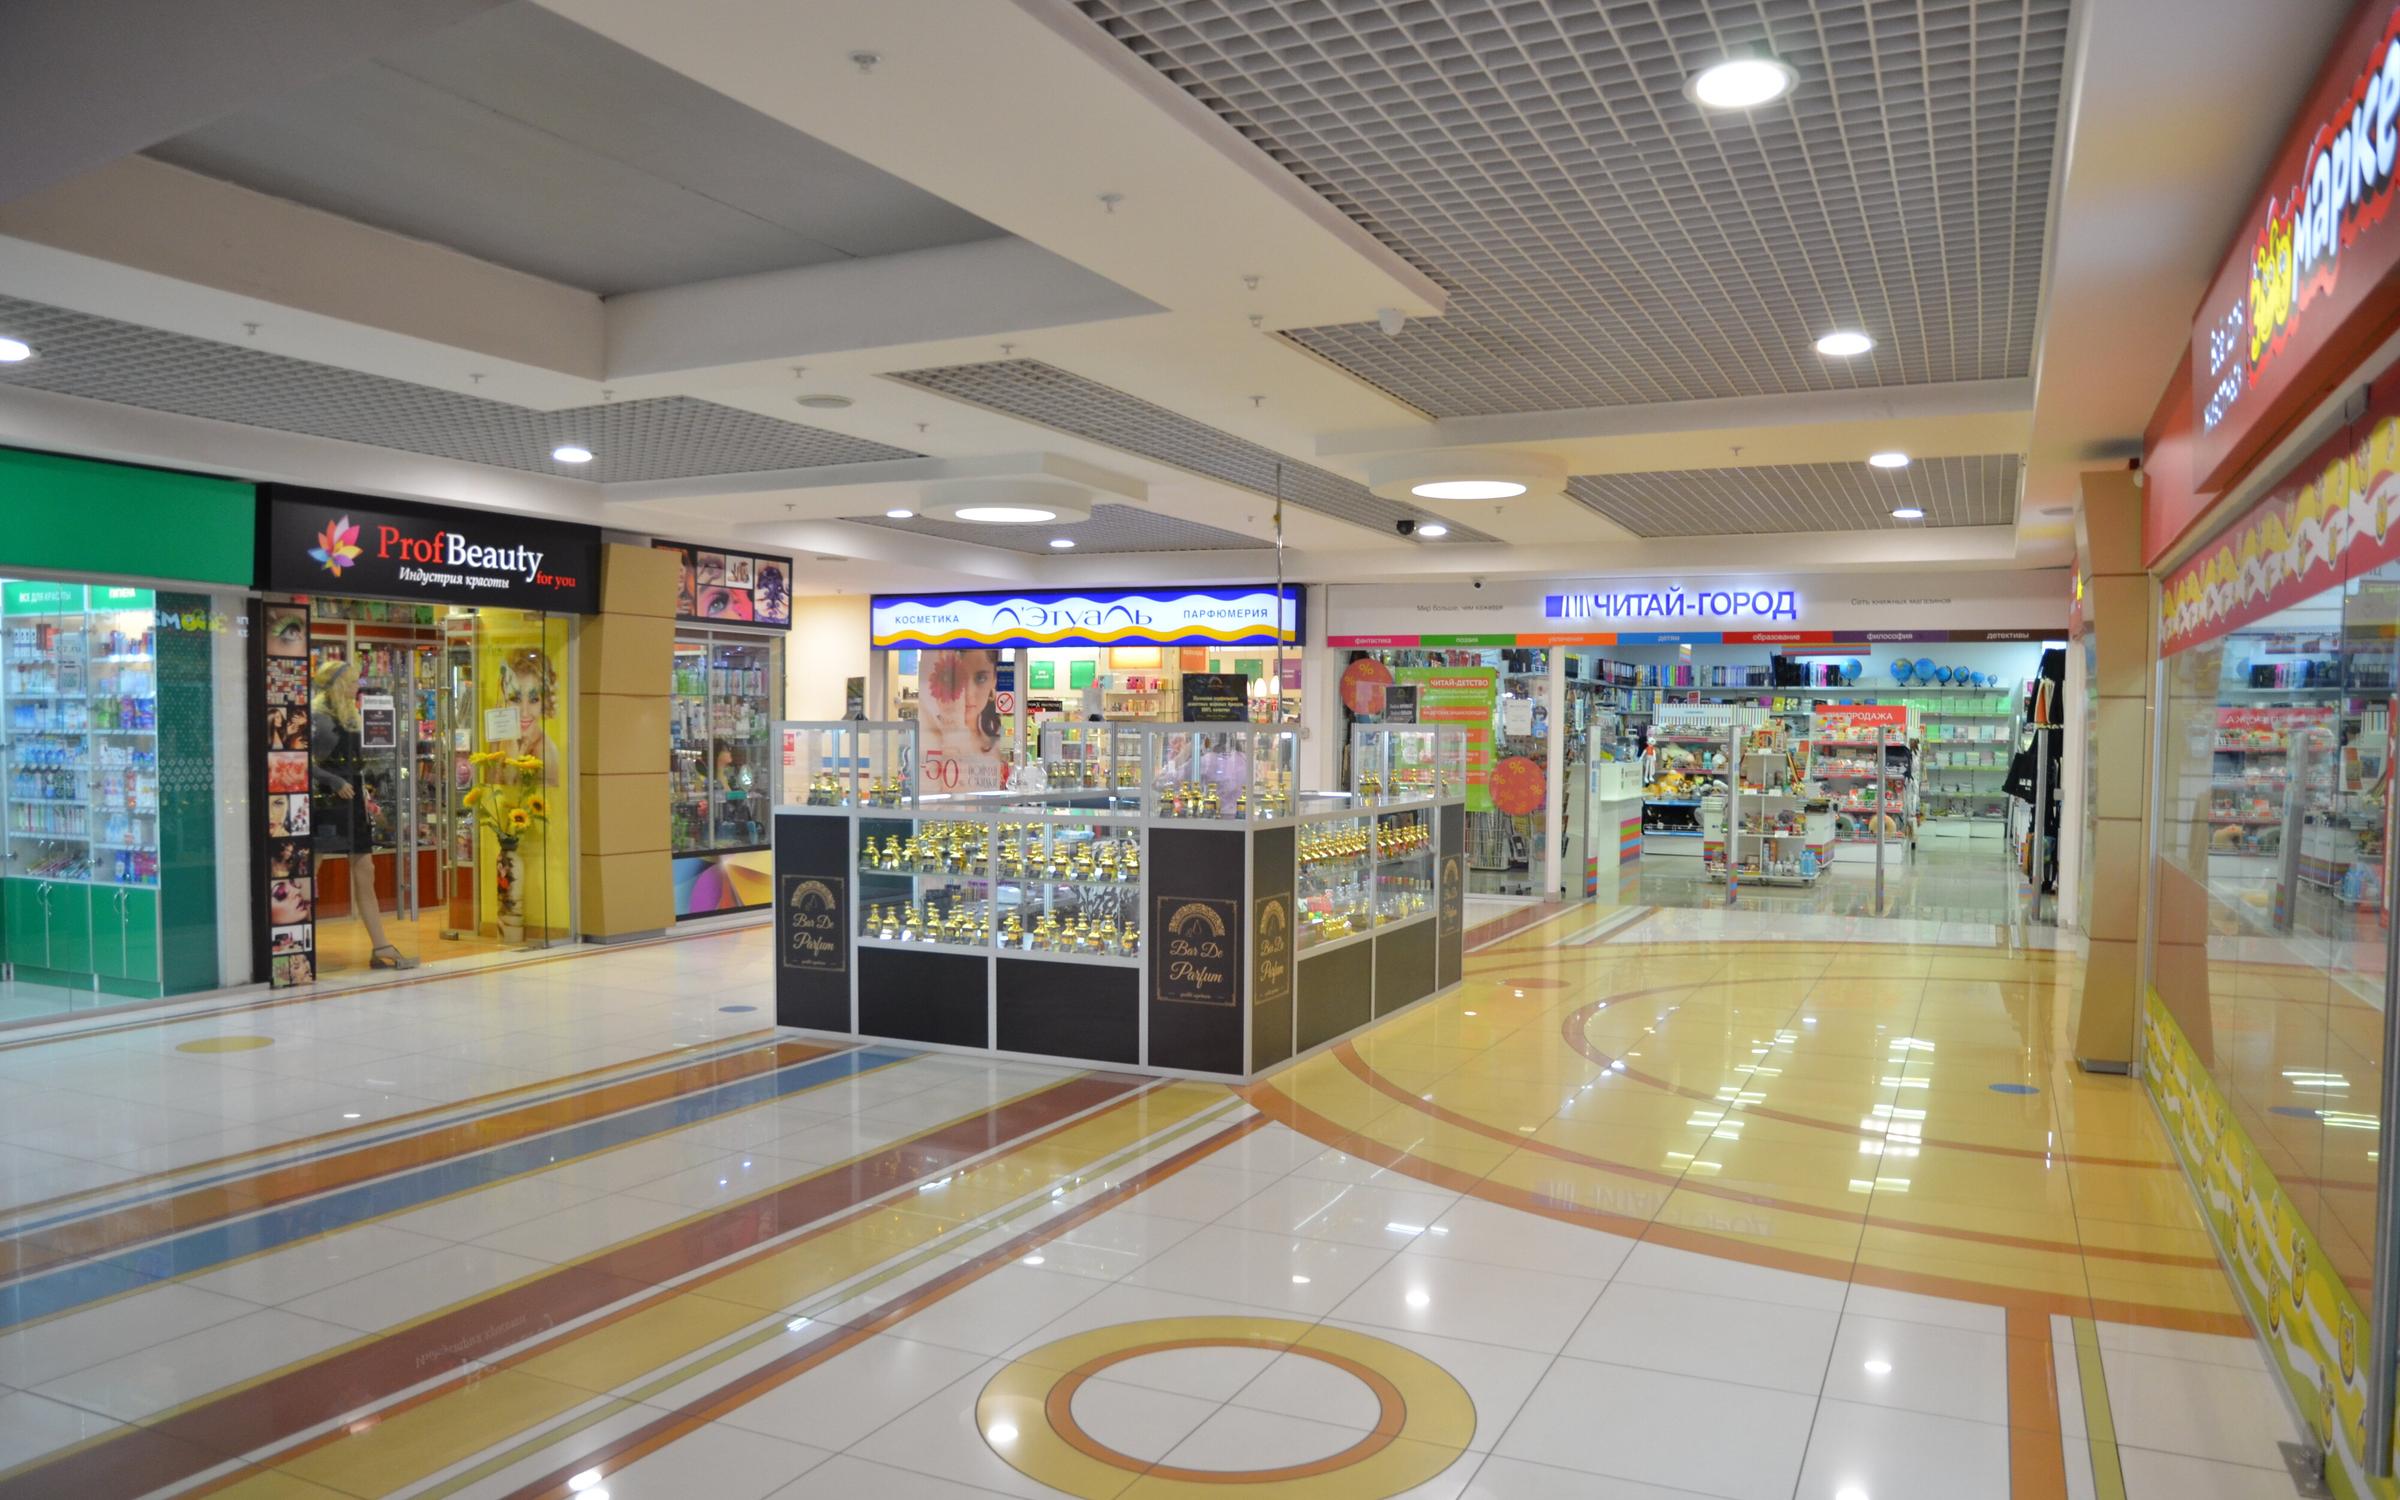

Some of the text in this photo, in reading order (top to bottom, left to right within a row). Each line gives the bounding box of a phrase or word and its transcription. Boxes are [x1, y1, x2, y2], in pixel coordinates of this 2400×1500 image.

[399, 566, 510, 590] Индустрия красоты
[536, 570, 576, 590] for you
[1593, 586, 1797, 620] ЧИТАЙ-ГОРОД
[895, 614, 960, 625] КОСМЕТИКА
[1183, 607, 1269, 620] ПАРФЮМЕРИЯ
[1354, 636, 1392, 645] фантастика
[1752, 632, 1800, 641] образование
[1866, 631, 1914, 641] философия
[1986, 631, 2030, 641] детективы
[1430, 679, 1489, 688] ЧИТАЙ-ДЕТСТВО
[1829, 711, 1893, 722] ПРОДАЖА
[792, 912, 835, 929] Bar De
[792, 931, 835, 957] Parfum
[1169, 939, 1224, 959] Bar De
[1169, 960, 1223, 989] Parfum
